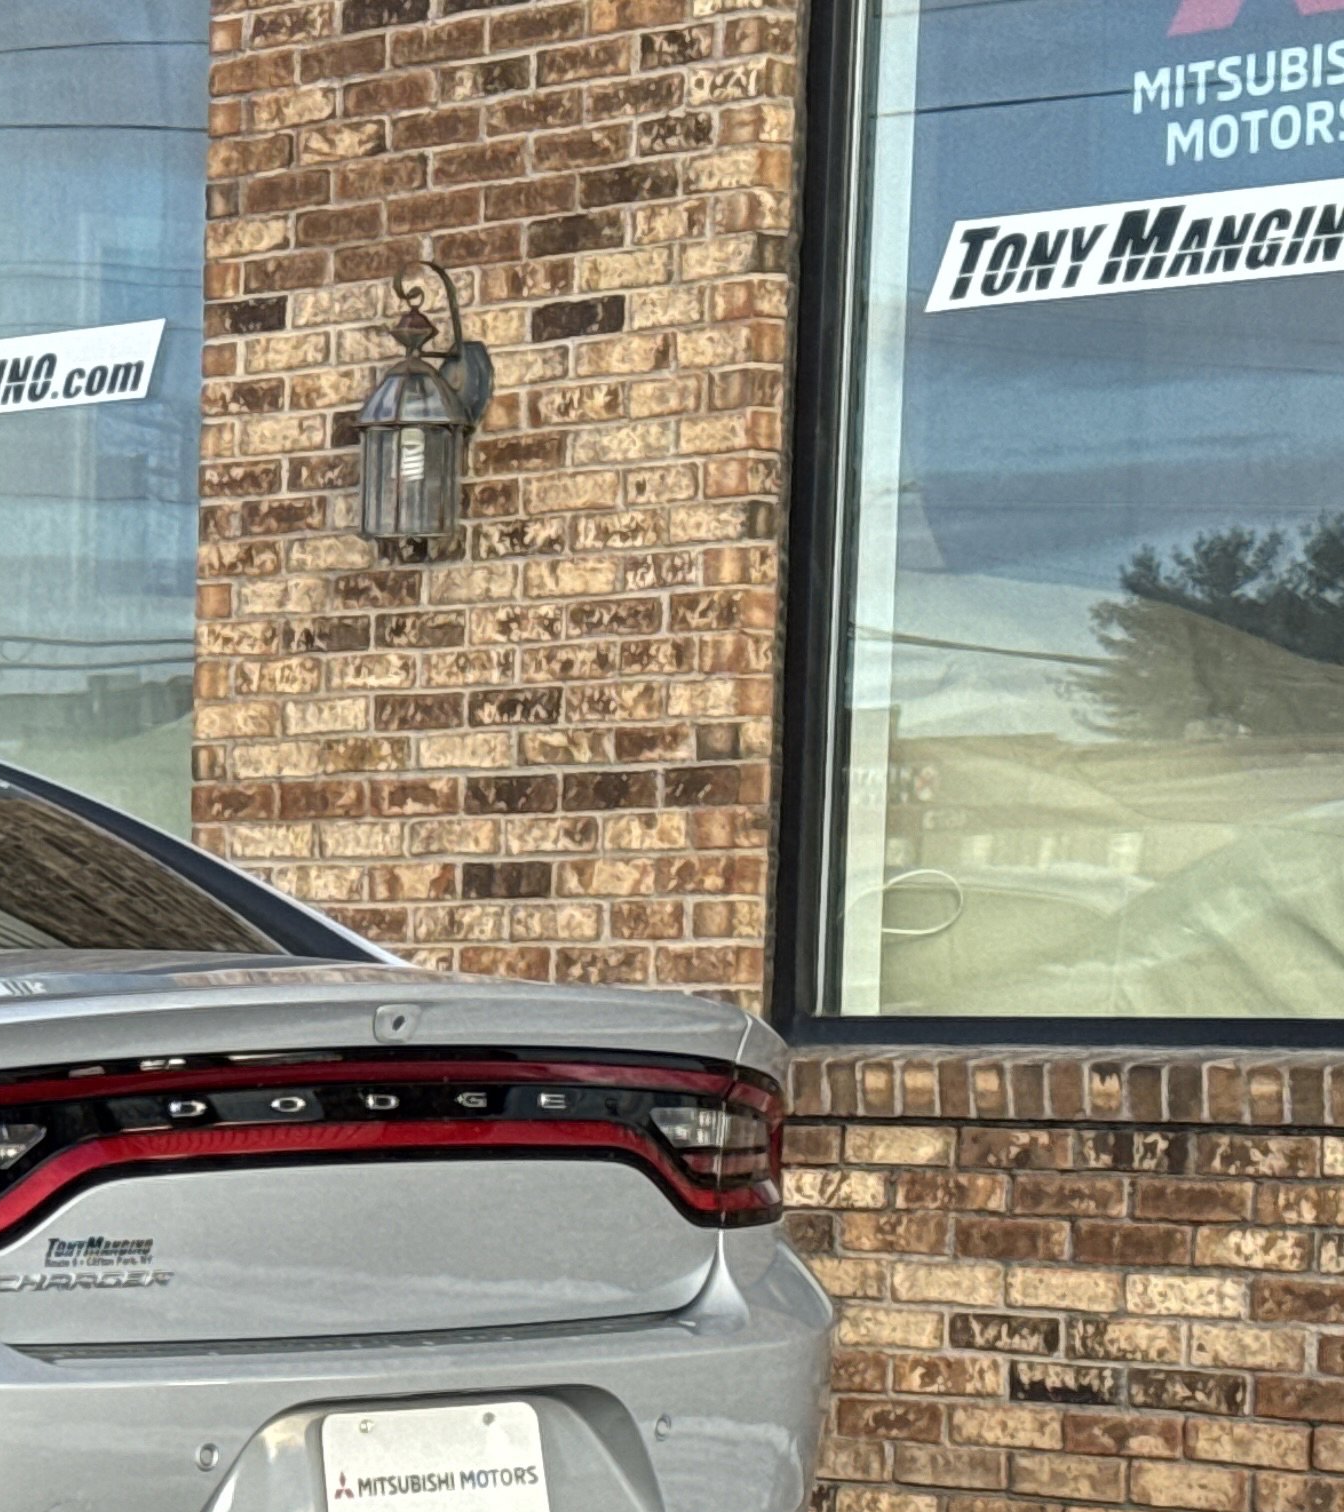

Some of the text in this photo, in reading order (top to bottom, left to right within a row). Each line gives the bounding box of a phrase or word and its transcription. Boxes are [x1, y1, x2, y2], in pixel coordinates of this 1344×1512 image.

[1132, 39, 1344, 115] MITSUBIS
[1166, 97, 1344, 166] MOTOR
[168, 1091, 566, 1118] DODGE
[357, 1465, 539, 1498] MITSUBISHI MOTORS
